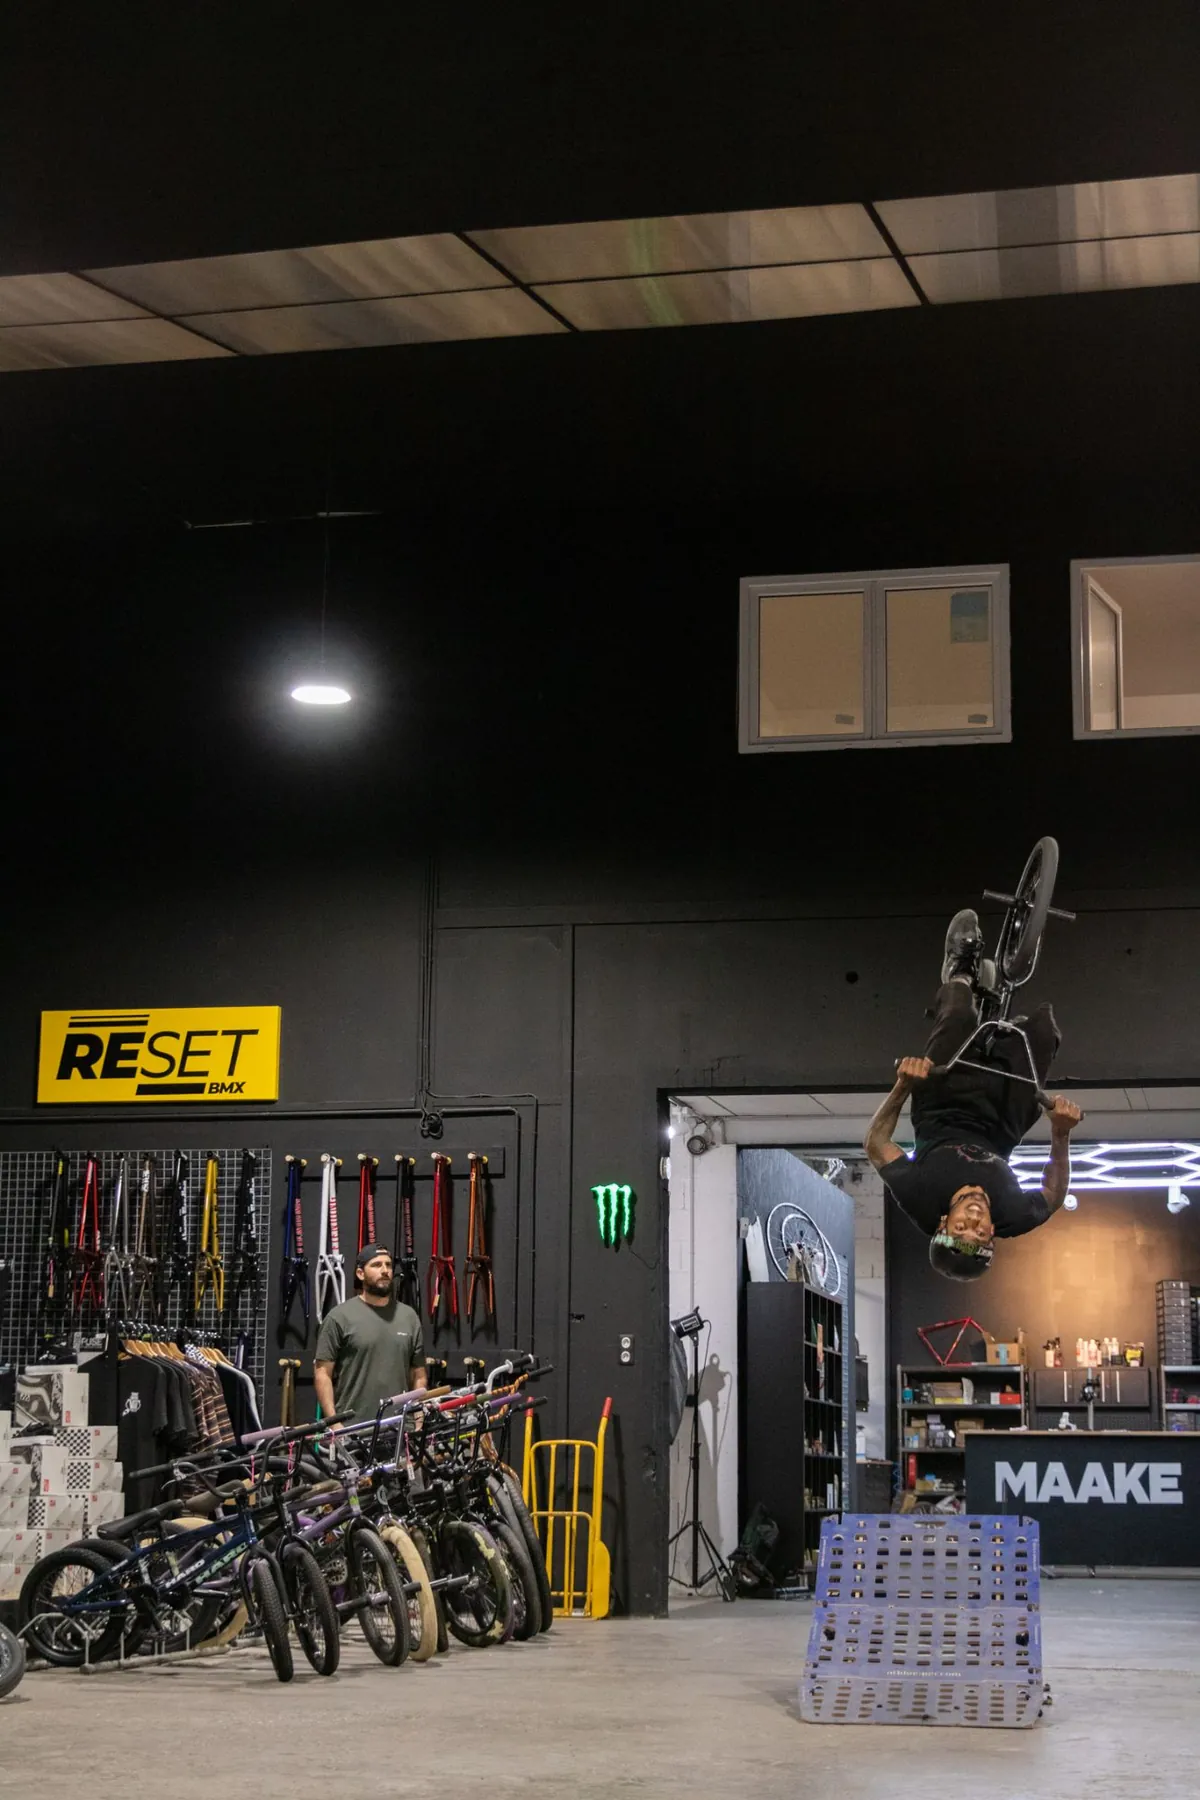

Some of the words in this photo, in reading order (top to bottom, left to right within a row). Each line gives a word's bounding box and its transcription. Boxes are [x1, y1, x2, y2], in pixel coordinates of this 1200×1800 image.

[56, 1029, 259, 1080] RESET
[208, 1082, 246, 1094] BMX
[995, 1461, 1184, 1504] MAAKE
